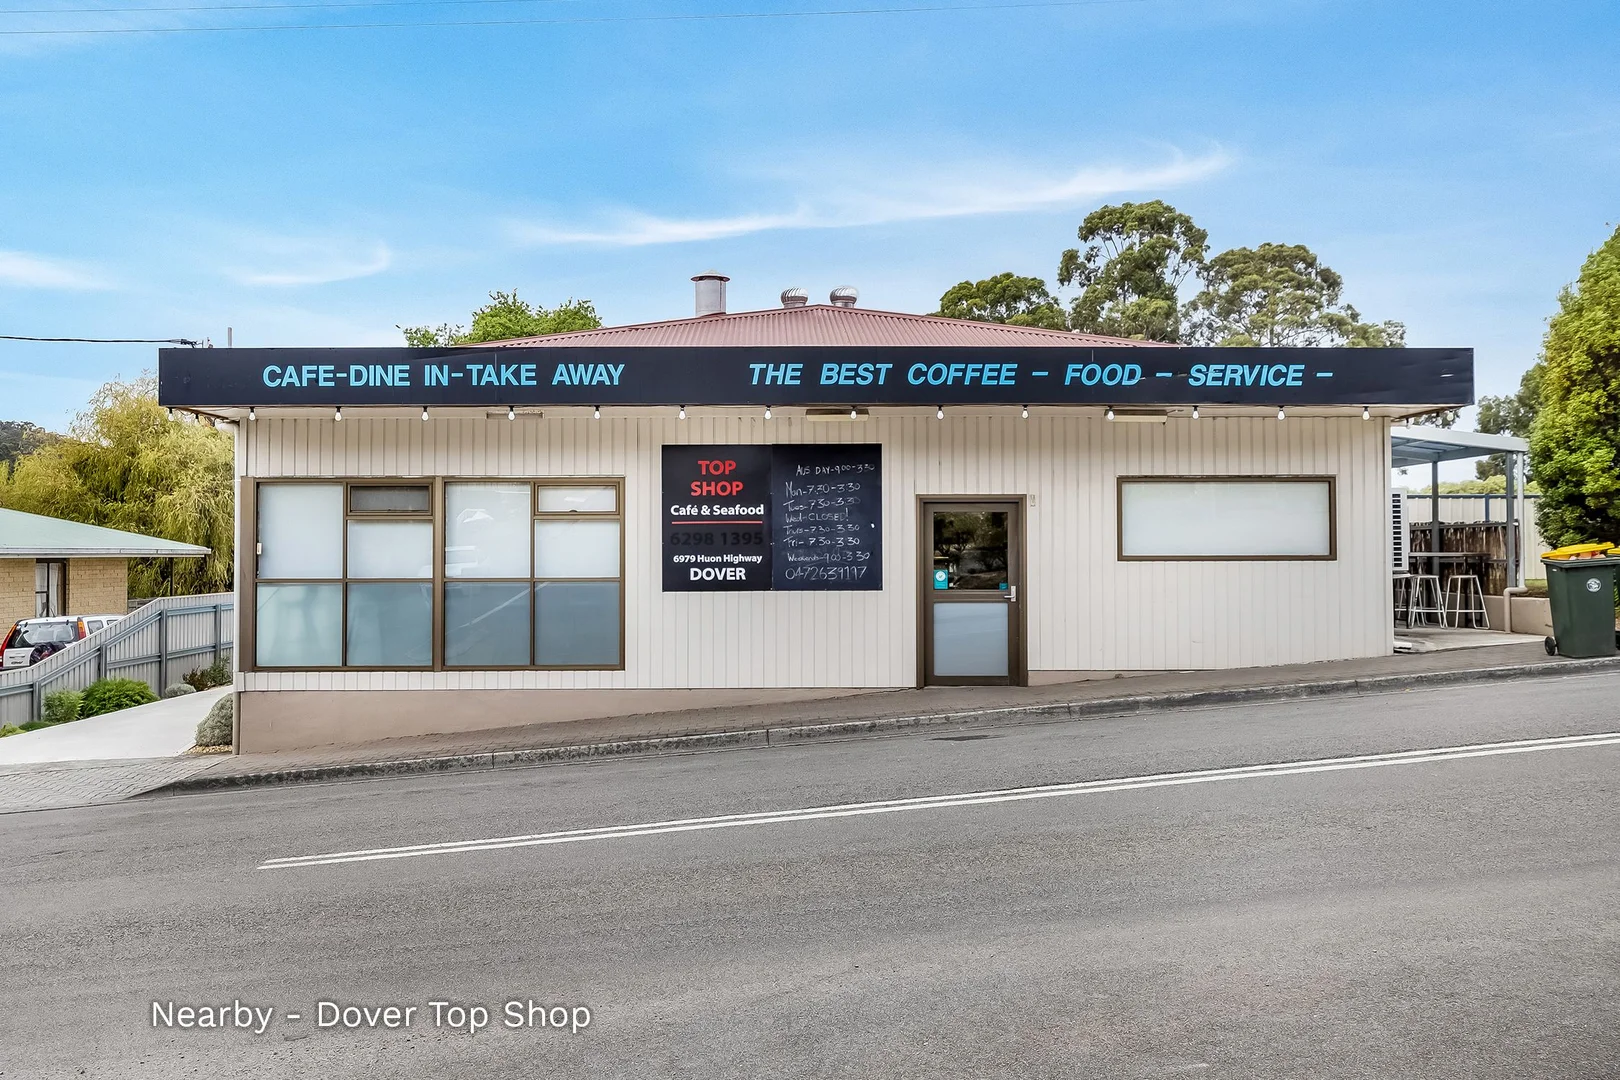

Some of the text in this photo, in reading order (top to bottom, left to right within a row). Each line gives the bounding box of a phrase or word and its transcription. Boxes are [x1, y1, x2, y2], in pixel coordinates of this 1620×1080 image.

[262, 363, 625, 387] CAFE-DINE IN-TAKE AWAY
[749, 363, 803, 385] THE
[819, 363, 893, 385] BEST
[907, 363, 1018, 385] COFFEE
[1064, 363, 1142, 386] FOOD
[1188, 364, 1305, 386] SERVICE
[697, 460, 737, 476] TOP
[690, 481, 744, 497] SHOP
[670, 504, 765, 516] Café & Seafood
[670, 532, 764, 546] 6298 1395
[673, 553, 763, 565] 6979 Huon Highway
[689, 567, 747, 581] DOVER
